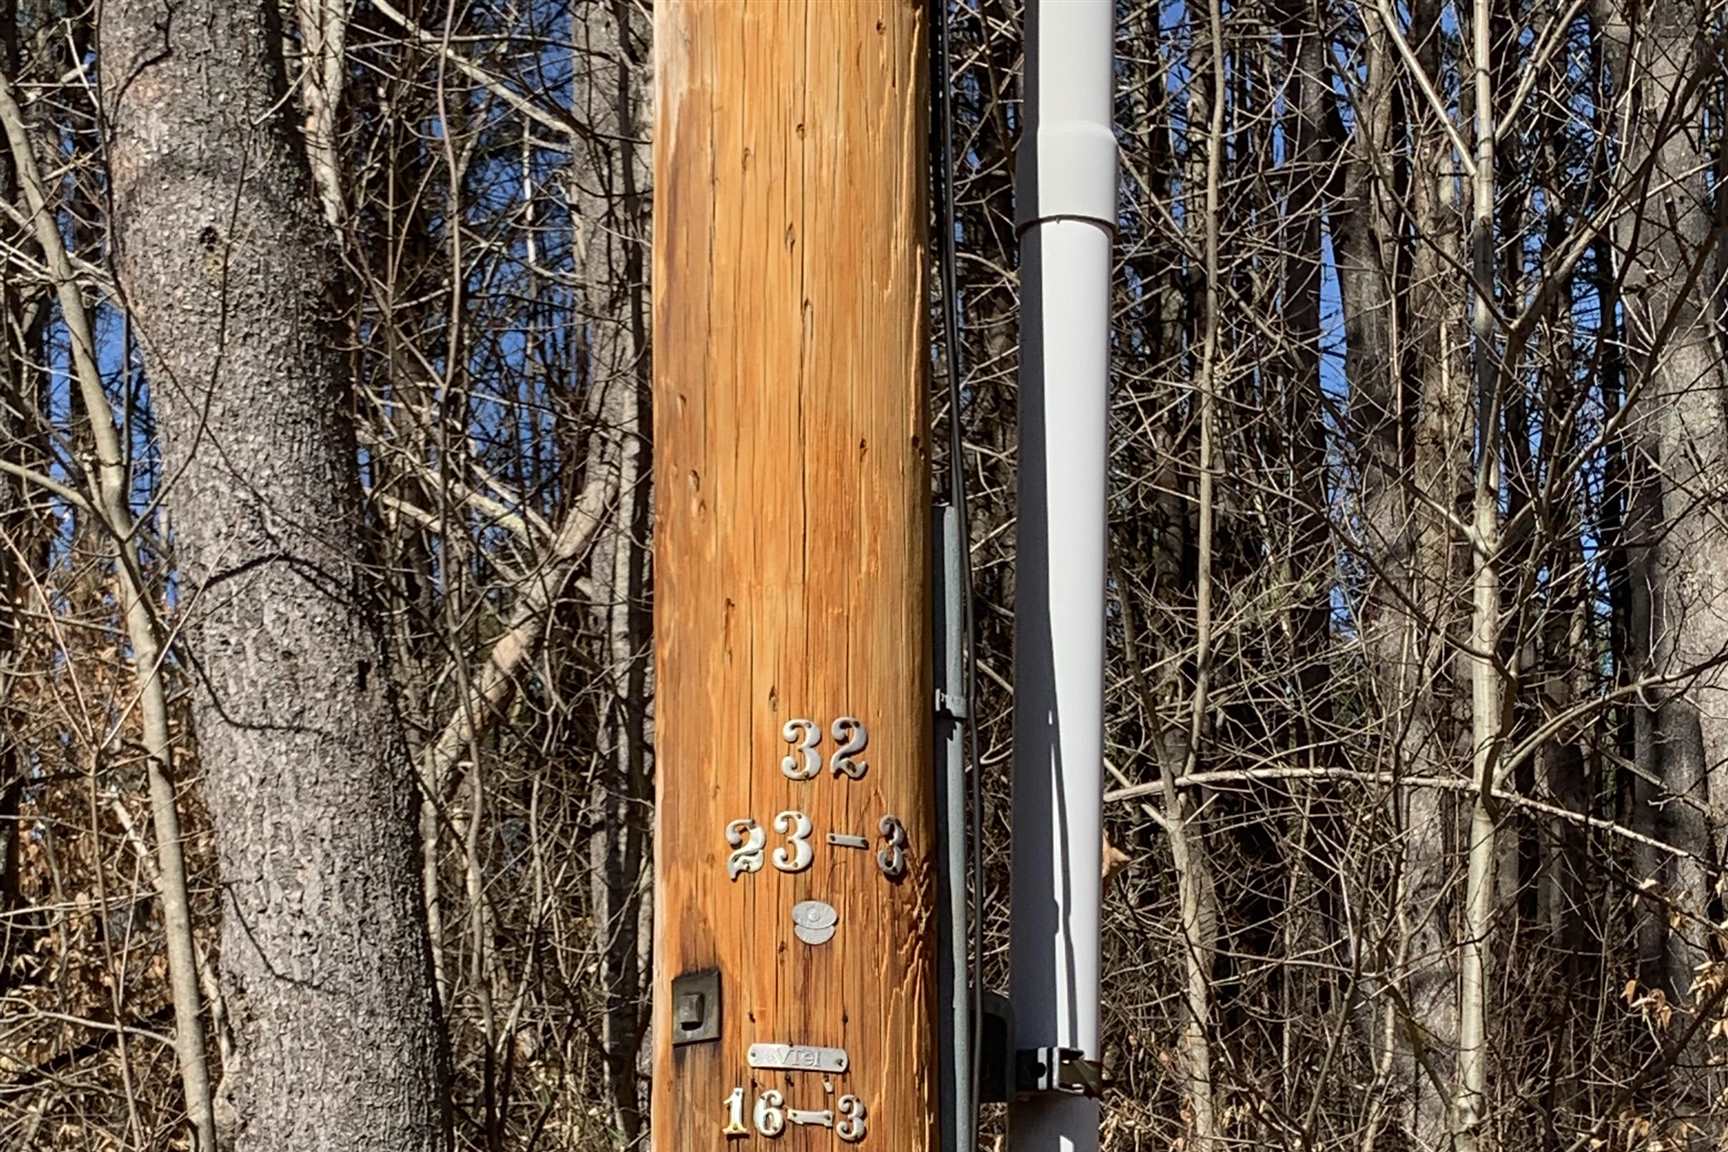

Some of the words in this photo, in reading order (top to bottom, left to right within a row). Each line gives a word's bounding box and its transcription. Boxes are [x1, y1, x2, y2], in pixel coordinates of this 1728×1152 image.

[781, 716, 868, 780] 32
[725, 810, 904, 880] 23-3
[722, 1087, 867, 1141] 16-3
